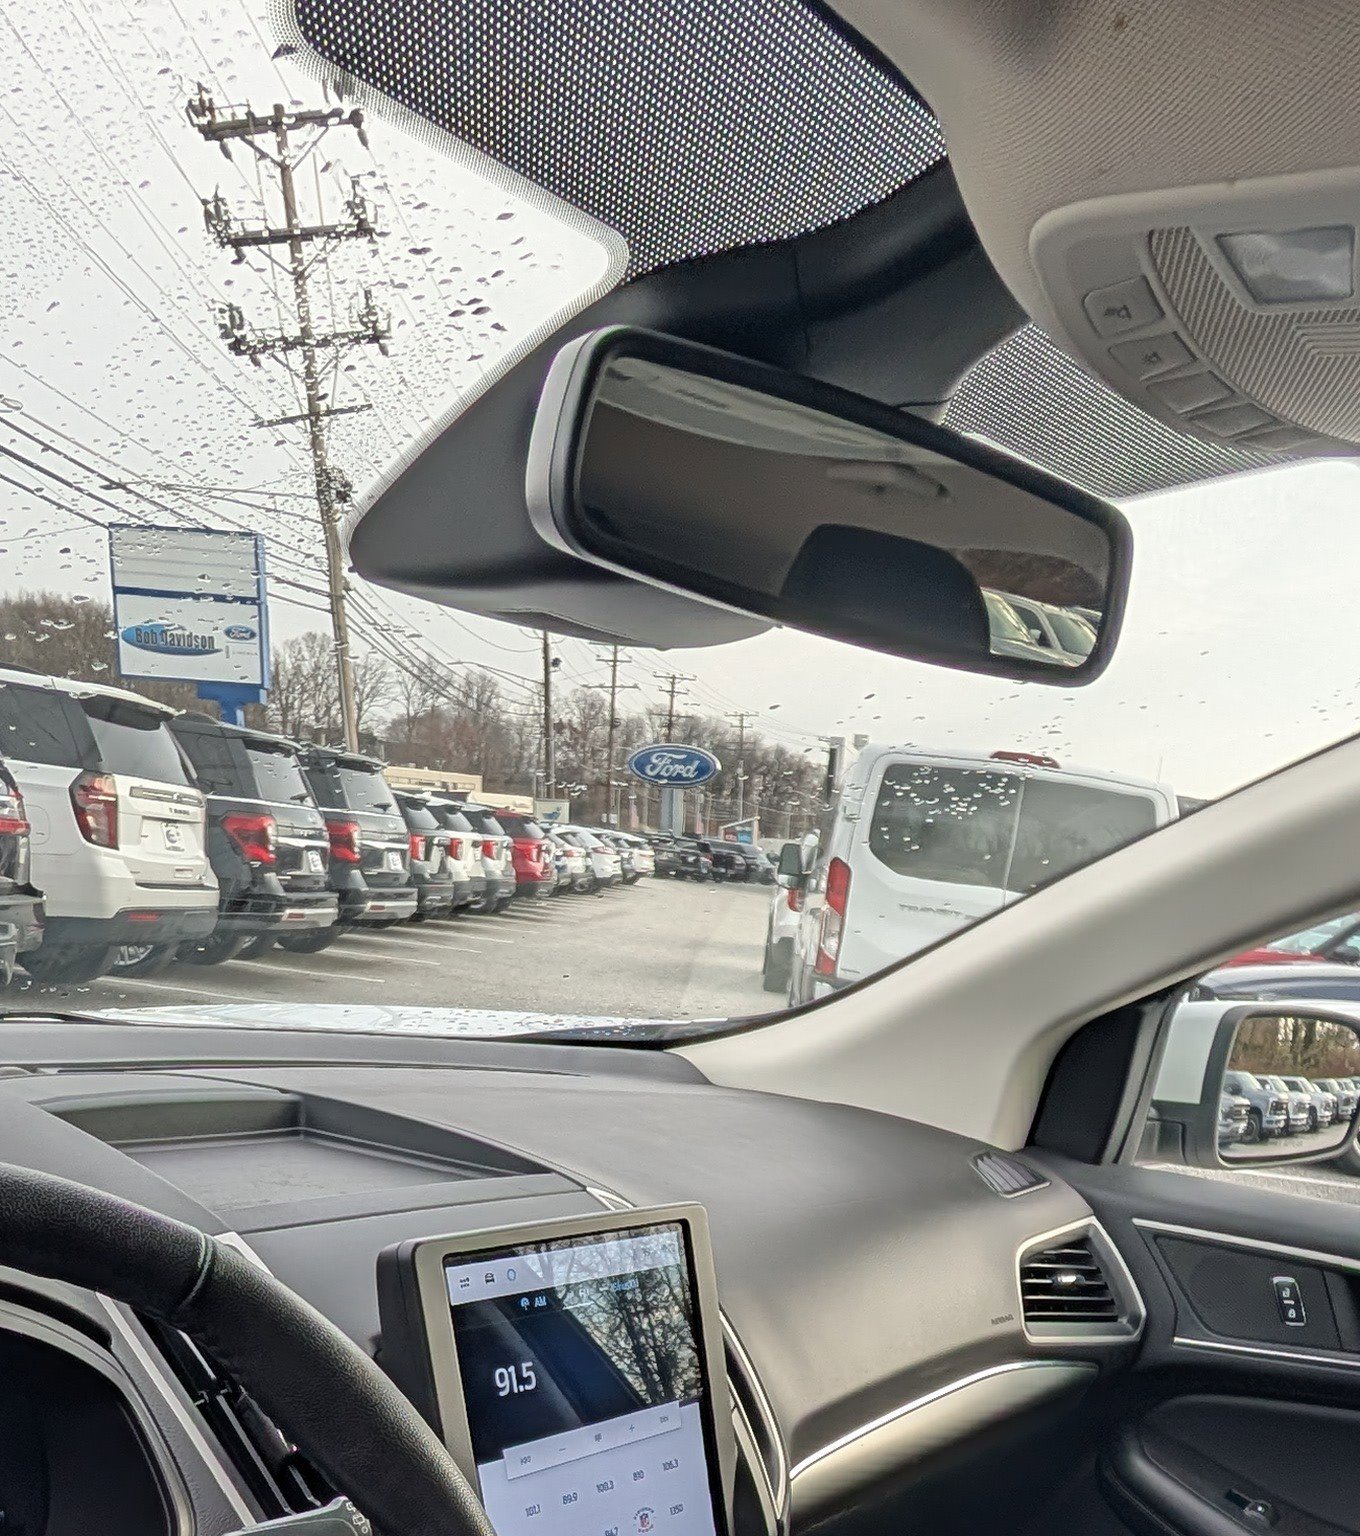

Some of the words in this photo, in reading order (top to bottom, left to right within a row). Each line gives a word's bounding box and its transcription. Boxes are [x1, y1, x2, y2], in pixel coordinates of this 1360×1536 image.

[135, 628, 158, 645] Bob
[162, 630, 215, 650] Davidson
[644, 752, 701, 778] Ford
[495, 1361, 537, 1397] 91.5
